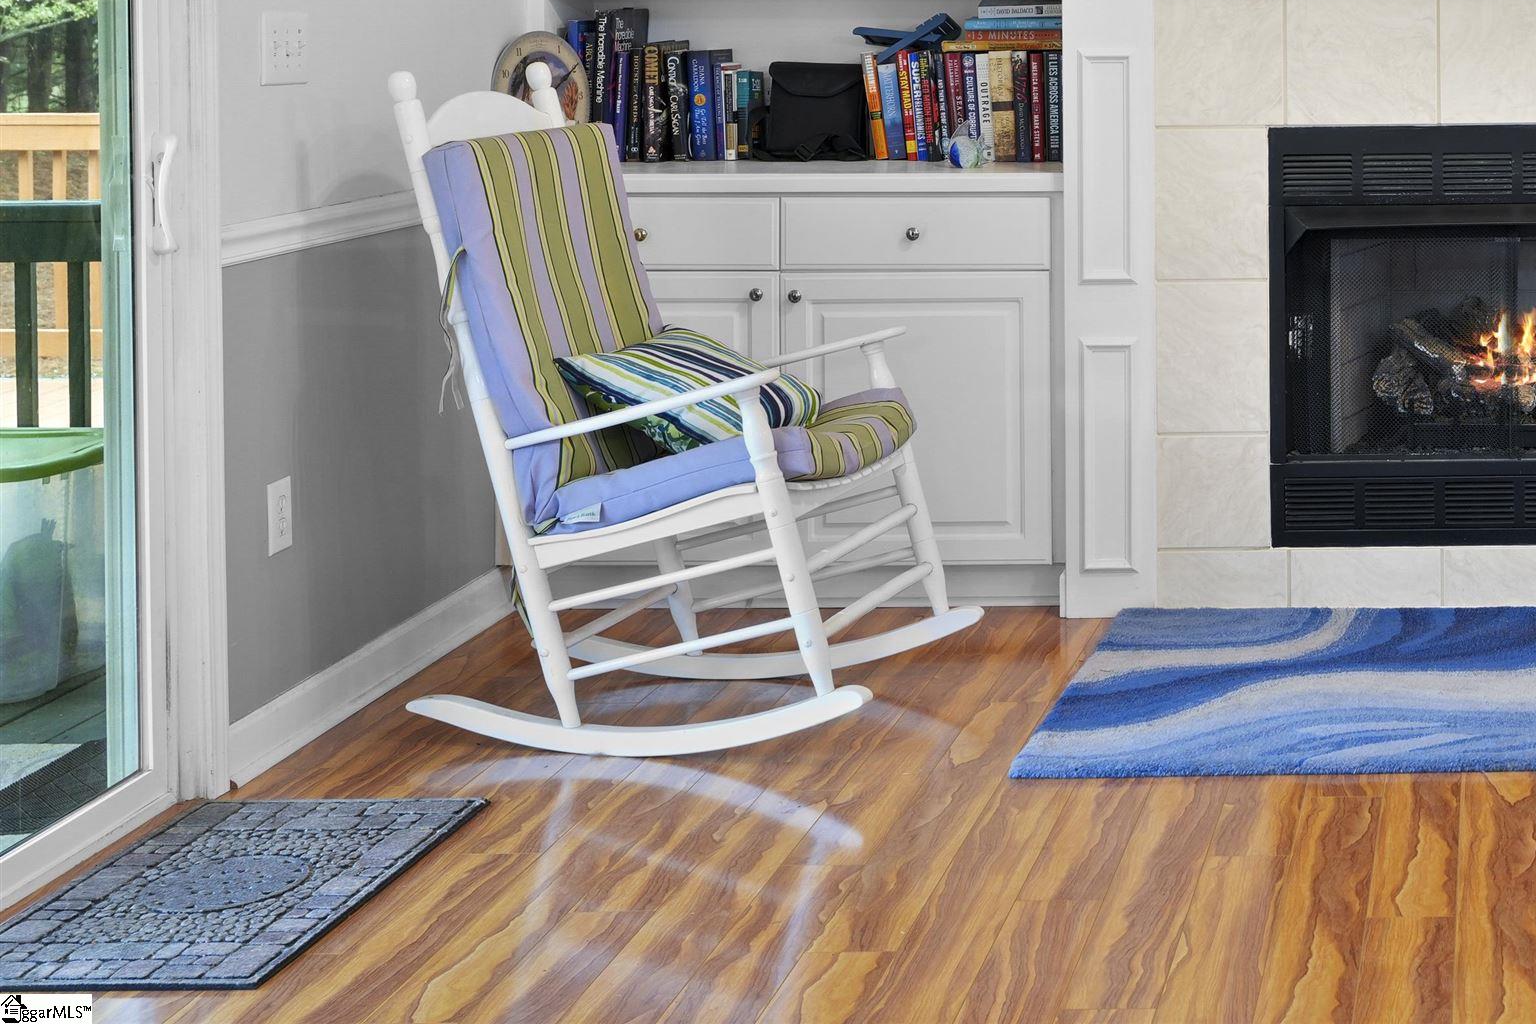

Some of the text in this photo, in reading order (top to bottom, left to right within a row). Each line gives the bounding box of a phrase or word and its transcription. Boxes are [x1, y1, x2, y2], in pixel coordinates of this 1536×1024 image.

[516, 48, 522, 56] 11
[972, 30, 1036, 40] 15 MINUTES
[502, 70, 510, 78] 10
[595, 16, 607, 104] The Incredible Machine
[644, 46, 658, 86] COMET
[996, 58, 1004, 96] HISTORIAN
[883, 73, 896, 116] MATTERHORN
[899, 71, 912, 109] STAY MAD
[966, 76, 976, 138] CULTURE OF CORRUPT
[980, 82, 990, 124] OUTRAGE
[1016, 76, 1028, 102] 1776
[1048, 62, 1059, 134] LIES ACROSS AMERICA
[670, 95, 681, 136] CARL SAGAN
[922, 79, 934, 143] RED MOON RISING
